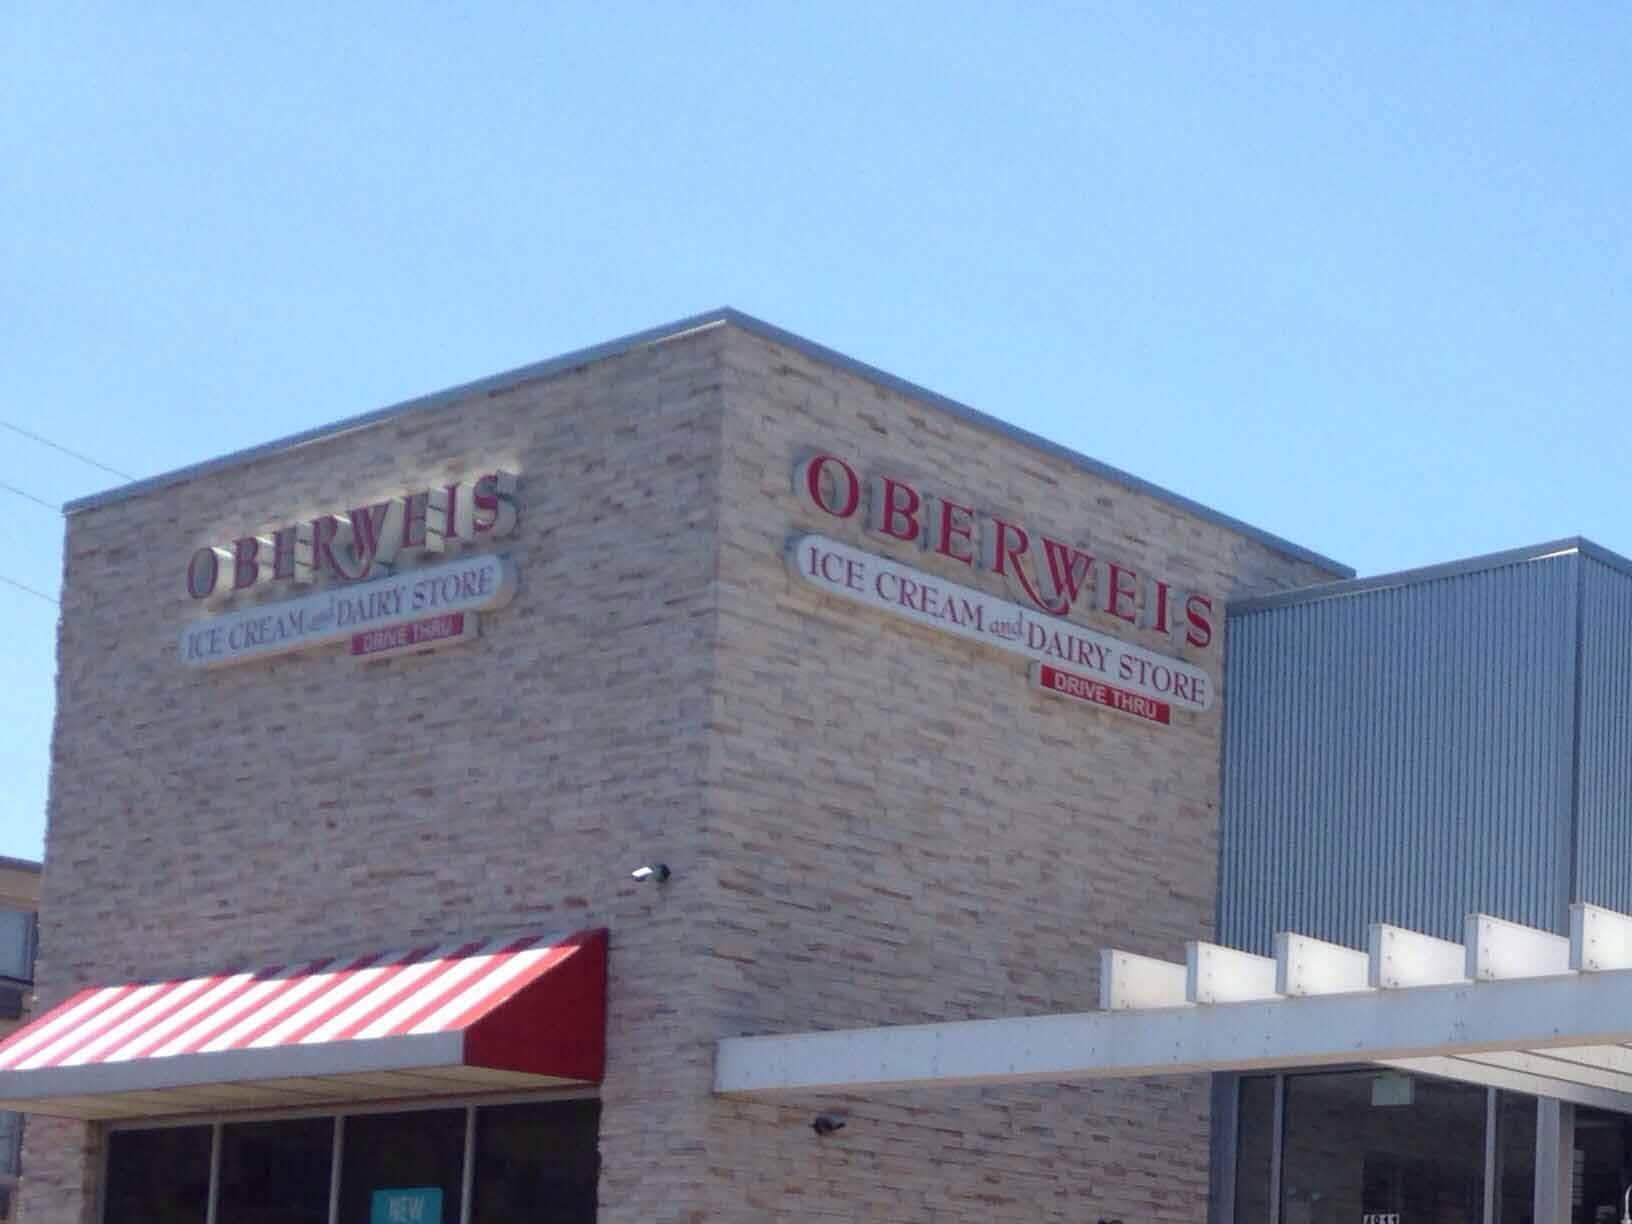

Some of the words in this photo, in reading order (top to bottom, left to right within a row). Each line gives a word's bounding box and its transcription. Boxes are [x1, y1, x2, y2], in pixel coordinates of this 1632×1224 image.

[187, 472, 506, 599] OBERWEIS
[807, 453, 1213, 648] OBERWEIS
[187, 623, 222, 660] ICE
[226, 608, 305, 653] CREAM
[336, 586, 408, 627] DAIRY
[412, 566, 494, 608] STORE
[808, 545, 865, 592] ICE
[875, 571, 984, 633] CREAM
[988, 611, 1024, 639] and
[1025, 624, 1113, 673] DAIRY
[1118, 653, 1207, 708] STORE
[1054, 671, 1106, 706] DRIVE
[1111, 688, 1157, 721] THRU
[387, 1196, 424, 1222] NEW
